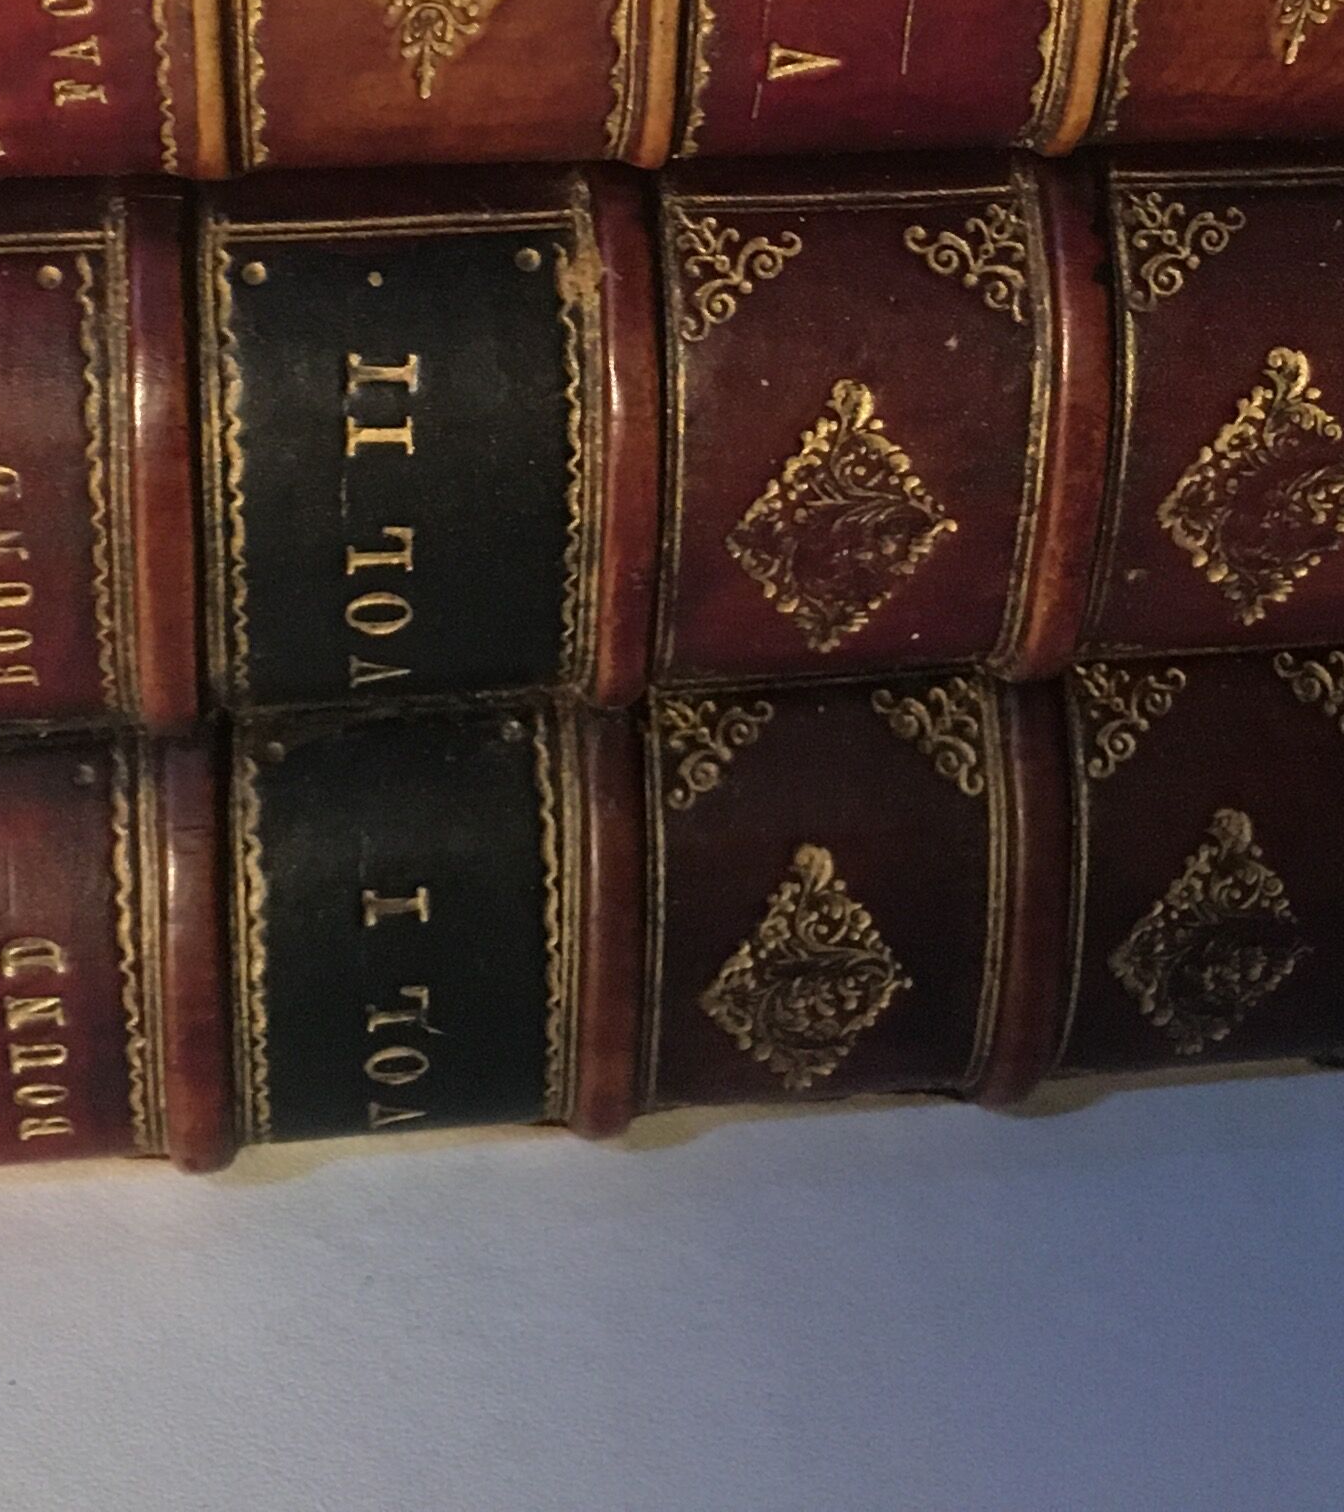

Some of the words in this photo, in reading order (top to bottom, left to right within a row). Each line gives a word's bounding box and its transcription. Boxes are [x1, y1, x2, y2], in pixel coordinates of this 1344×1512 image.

[347, 352, 419, 457] II
[345, 525, 415, 688] VOL
[362, 886, 429, 927] I
[1, 937, 74, 1141] BOUND
[363, 985, 432, 1129] VOL
